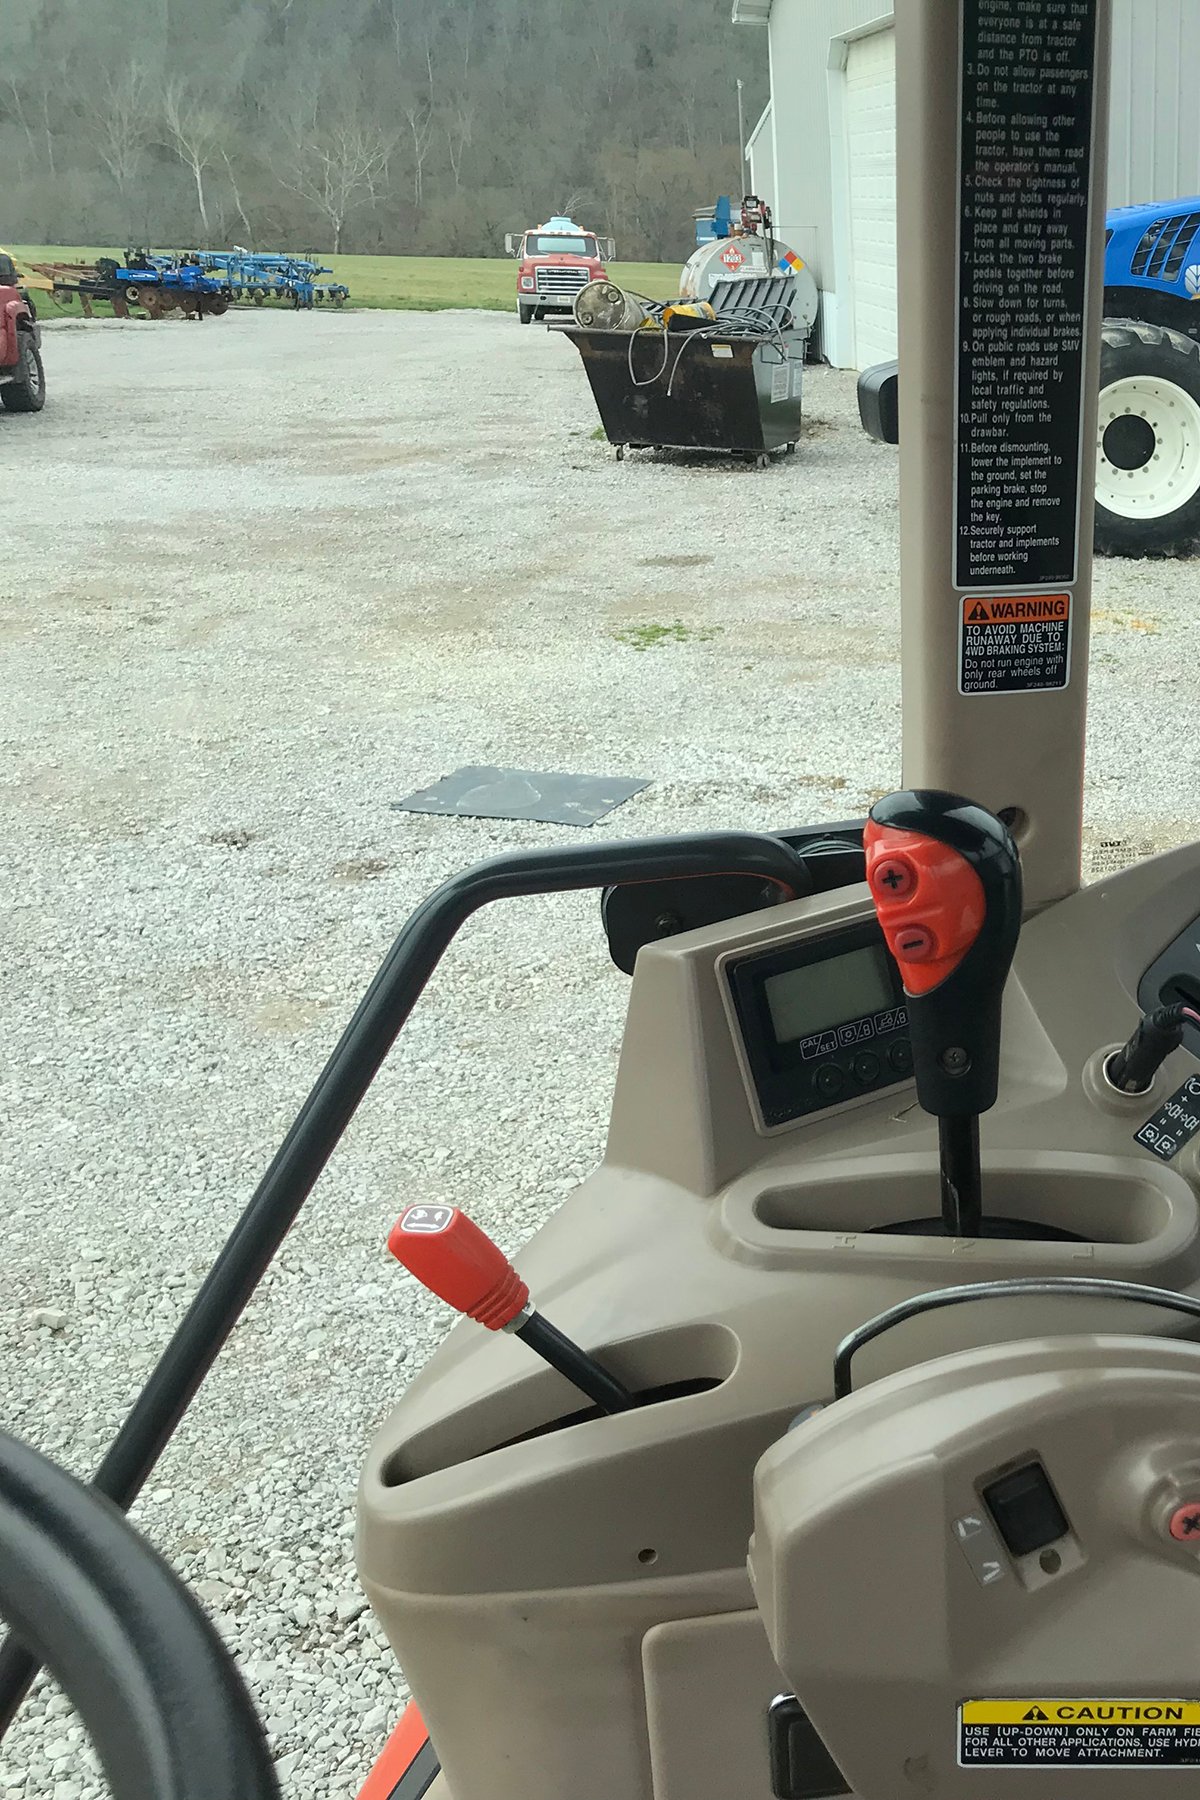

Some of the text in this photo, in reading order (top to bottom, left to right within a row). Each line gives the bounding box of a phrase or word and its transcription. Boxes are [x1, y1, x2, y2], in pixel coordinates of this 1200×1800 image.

[976, 145, 1084, 158] tractor, have them read
[976, 161, 989, 171] the
[1044, 162, 1077, 173] manual.
[975, 175, 1002, 187] Check
[1008, 177, 1021, 188] the
[1027, 177, 1066, 190] tightness
[1071, 178, 1079, 188] of
[975, 206, 996, 219] Keep
[1002, 207, 1012, 218] all
[1017, 208, 1048, 218] shields
[1053, 208, 1061, 218] in
[974, 238, 1075, 251] from all moving parts.
[974, 253, 994, 263] Lock
[1000, 253, 1013, 263] the
[1019, 254, 1034, 264] two
[1039, 253, 1062, 264] brake
[973, 268, 1074, 281] pedals together before
[973, 282, 1063, 296] driving on the road.
[973, 298, 994, 308] Slow
[999, 298, 1021, 308] down
[1027, 298, 1039, 308] for
[973, 313, 1080, 325] or rough roads, or when
[973, 326, 1081, 339] applying individual brakes.
[972, 341, 984, 351] On
[988, 342, 1013, 353] public
[1017, 341, 1040, 351] roads
[1044, 342, 1058, 351] use
[1062, 340, 1079, 351] SMV
[972, 355, 1058, 366] emblem and hazard
[972, 370, 1063, 383] lights, if required by
[972, 384, 1044, 395] local traffic and
[971, 399, 1050, 411] safety regulations.
[992, 413, 1010, 425] only
[1015, 413, 1034, 422] from
[1039, 413, 1051, 422] the
[971, 427, 1008, 437] drawbar.
[971, 456, 1062, 468] lower the implement to
[971, 470, 1047, 482] the ground, set the
[971, 484, 1047, 496] parking brake, stop
[971, 497, 1060, 510] the engine and remove
[971, 512, 1002, 523] the key.
[1007, 525, 1037, 536] support
[970, 537, 1060, 549] tractor and implements
[970, 552, 1028, 562] before working
[970, 565, 1015, 575] underneath.
[991, 600, 1065, 618] WARNING
[967, 621, 1064, 635] TO AVOID MACHINE
[966, 632, 1060, 646] RUNAWAY DUE TO
[965, 642, 1065, 656] 4WD BRAKING SYSTEM:
[965, 655, 1064, 668] Do not run engine with
[965, 665, 1057, 680] only rear wheels off
[964, 680, 998, 691] ground.
[802, 1038, 835, 1052] CAL SET
[1056, 1706, 1183, 1720] CAUTION
[965, 1727, 990, 1736] USE
[998, 1726, 1069, 1737] [UP-DOWN]
[1076, 1727, 1109, 1737] ONLY
[1116, 1728, 1134, 1737] ON
[1142, 1728, 1176, 1737] FARM
[965, 1737, 988, 1746] FOR
[992, 1737, 1013, 1746] ALL
[1018, 1737, 1056, 1746] OTHER
[1060, 1738, 1143, 1747] APPLICATIONS,
[1148, 1738, 1170, 1747] USE
[965, 1748, 1164, 1758] LEVER TO MOVE ATTACHMENT.
